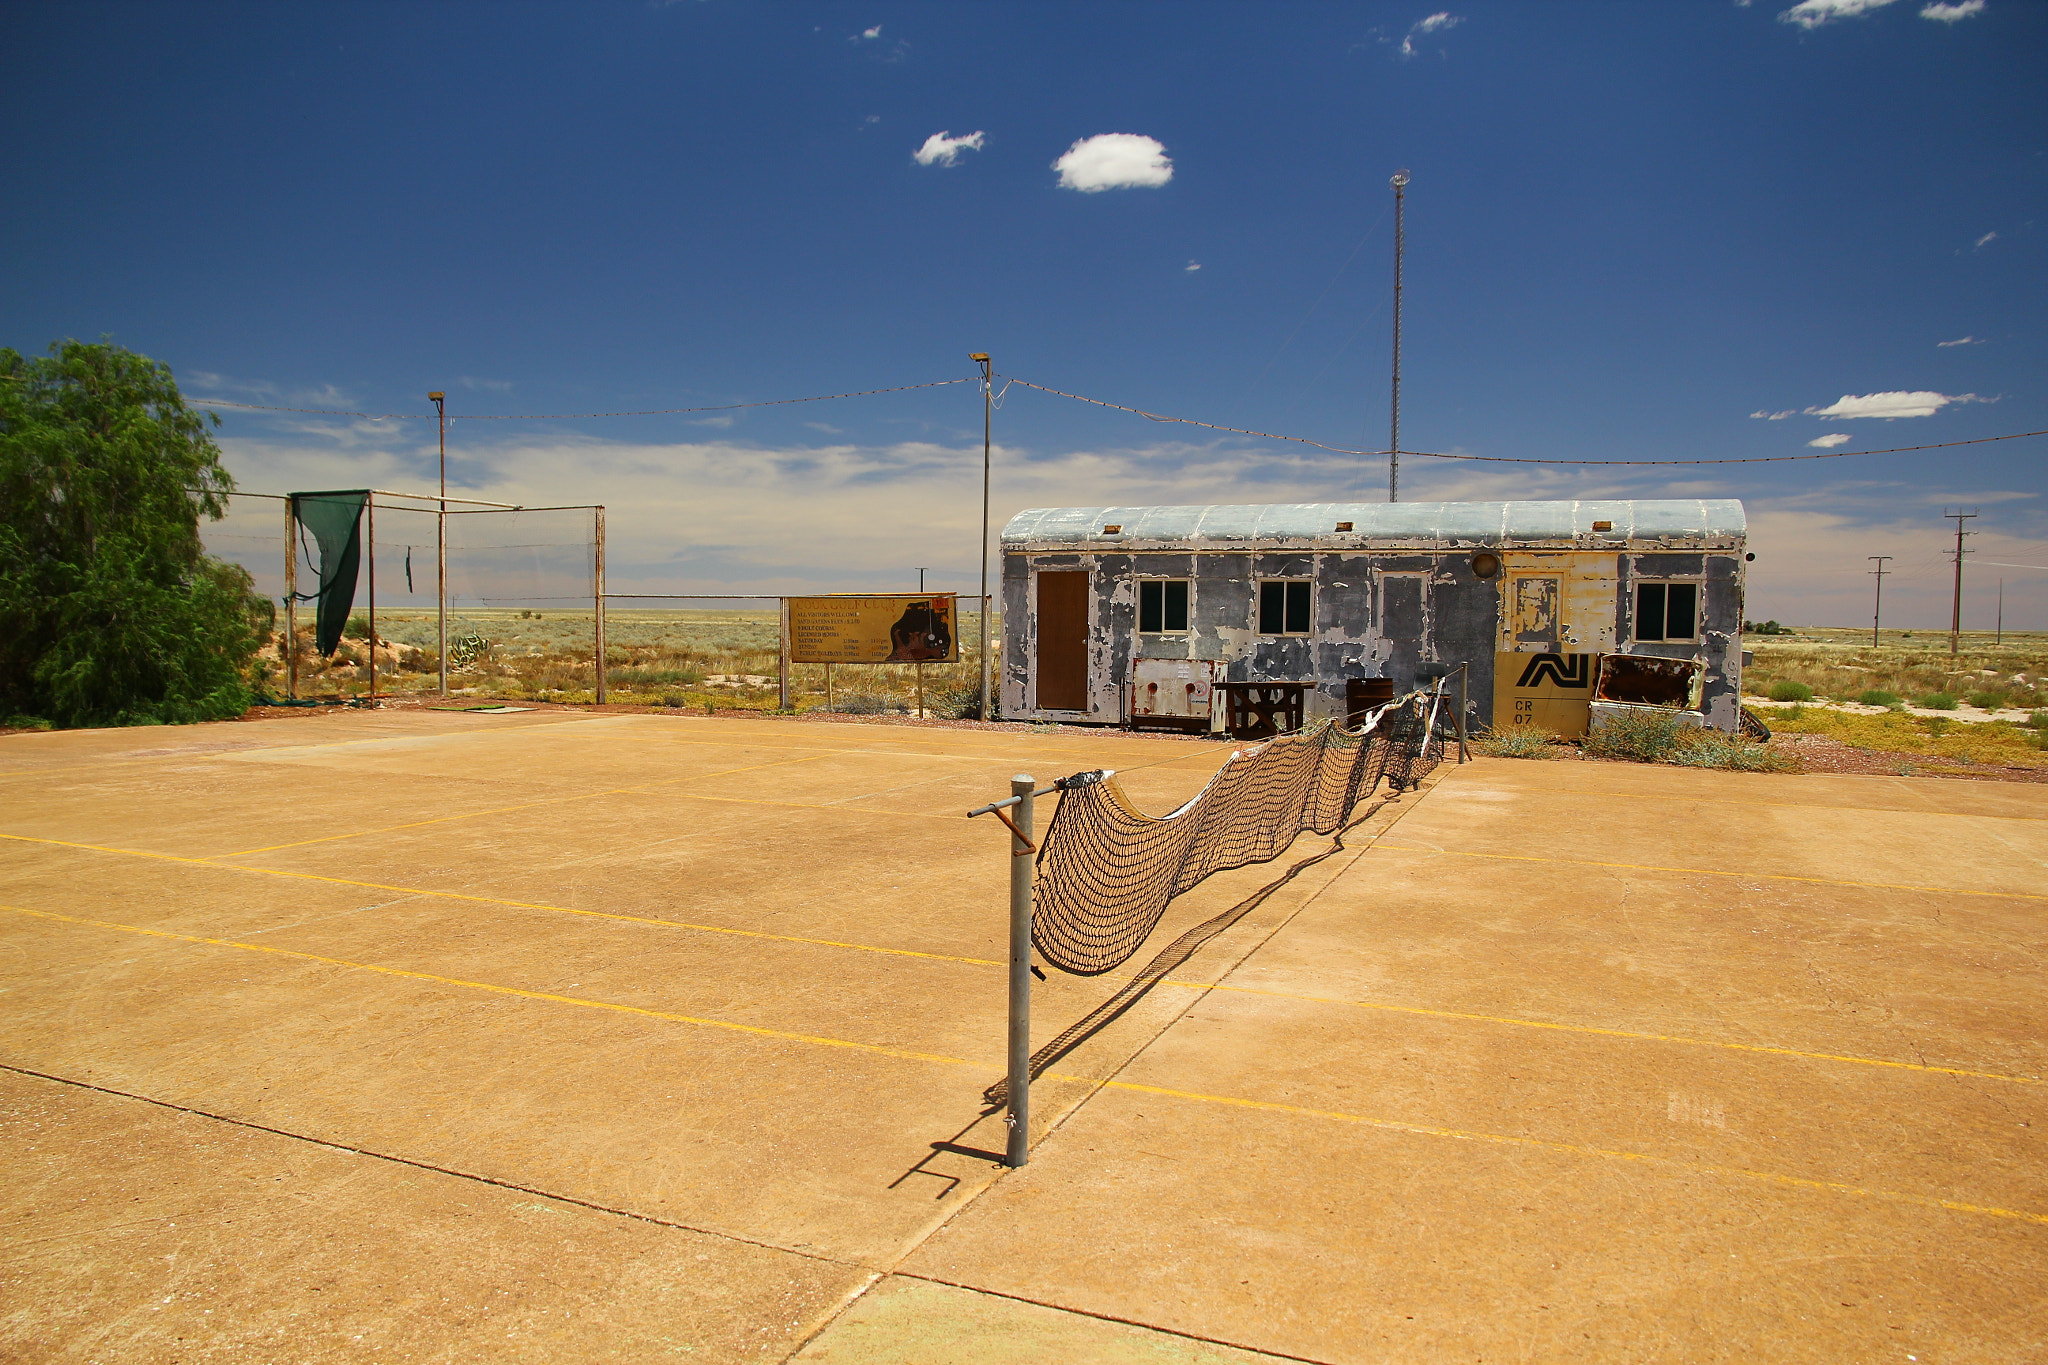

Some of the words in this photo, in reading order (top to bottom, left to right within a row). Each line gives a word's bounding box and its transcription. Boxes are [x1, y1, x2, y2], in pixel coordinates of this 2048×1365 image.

[830, 599, 862, 610] GOLF
[864, 598, 895, 610] CLUB
[1515, 700, 1533, 711] CR
[1515, 714, 1533, 725] 07
